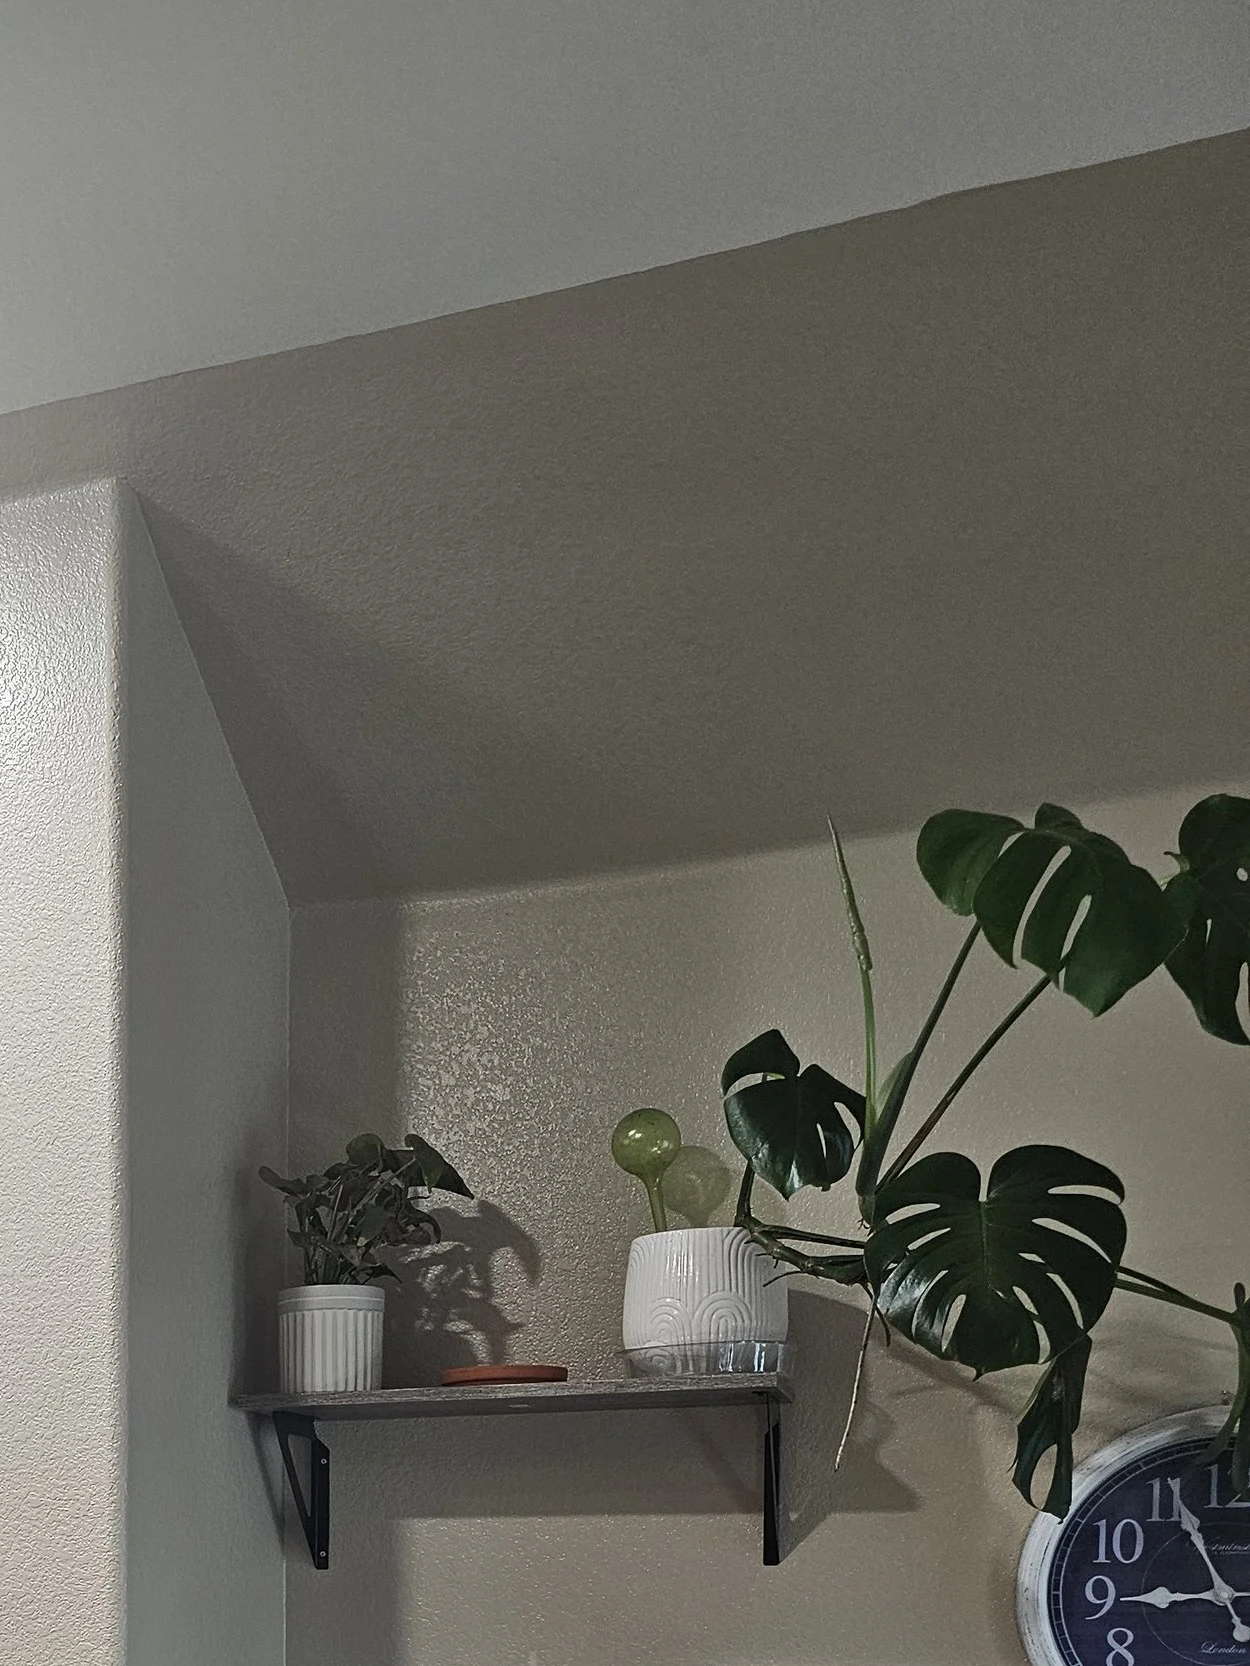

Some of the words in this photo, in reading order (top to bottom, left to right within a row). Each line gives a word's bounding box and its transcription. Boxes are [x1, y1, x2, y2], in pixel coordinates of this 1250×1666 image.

[1146, 1477, 1182, 1523] 11
[1092, 1518, 1144, 1564] 10
[1084, 1575, 1117, 1620] 9
[1201, 1641, 1247, 1655] London
